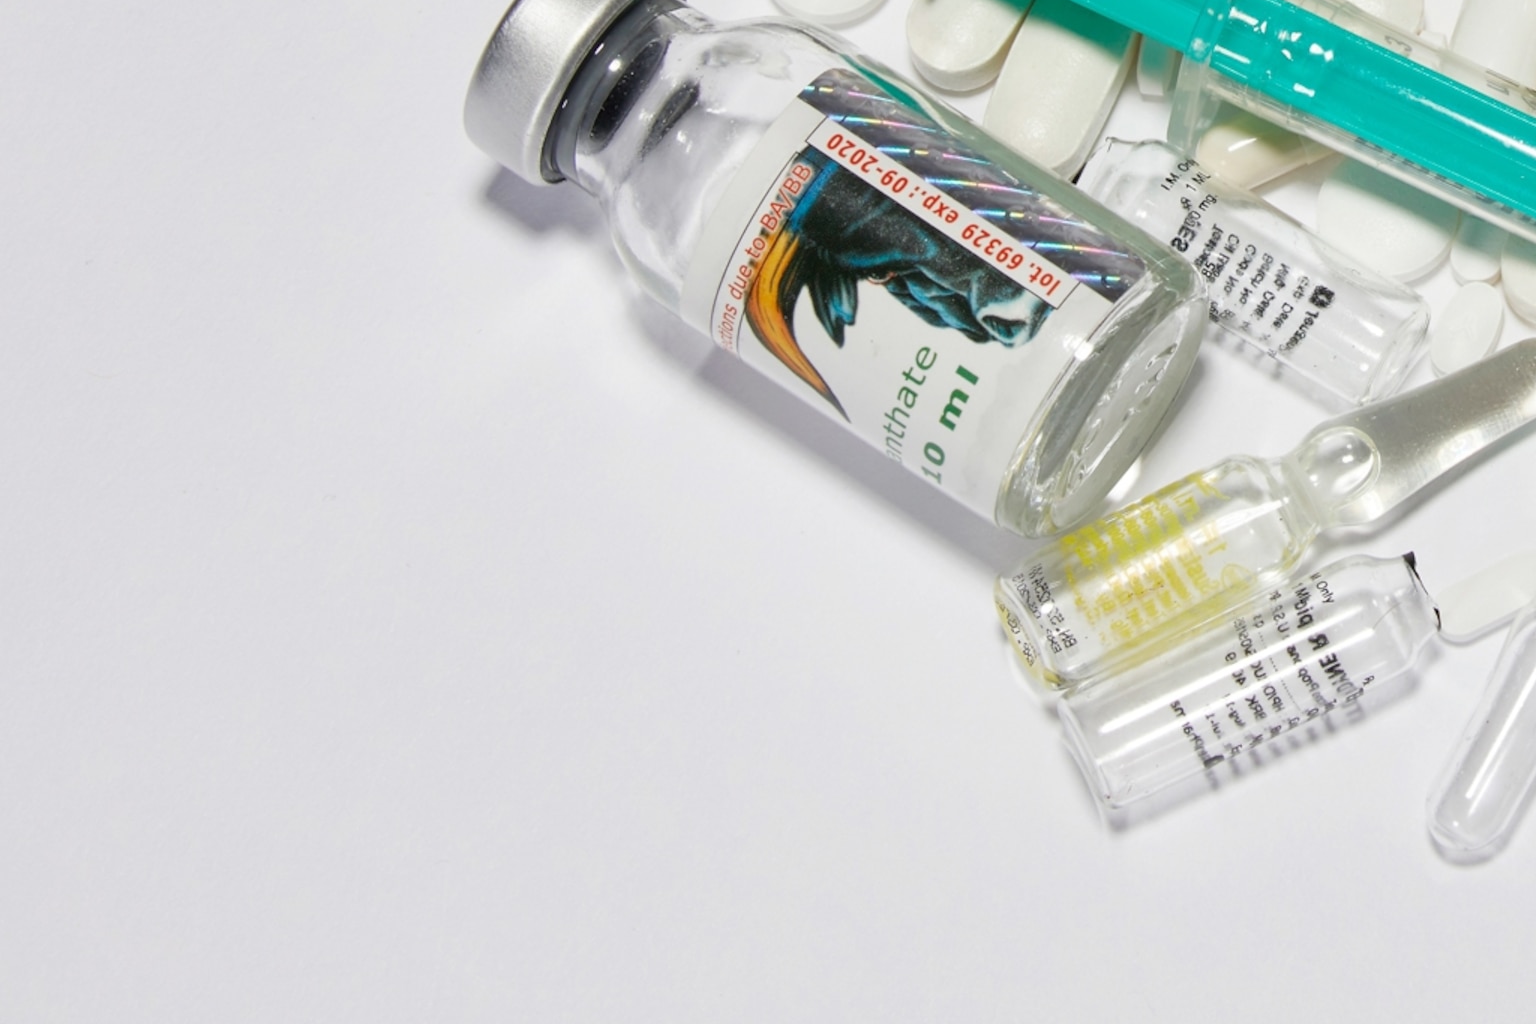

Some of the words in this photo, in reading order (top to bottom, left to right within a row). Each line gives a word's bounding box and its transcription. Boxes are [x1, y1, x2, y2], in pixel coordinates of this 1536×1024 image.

[826, 133, 909, 194] 09-2020
[908, 186, 959, 224] exp.:
[728, 264, 754, 301] due
[744, 236, 766, 259] to
[760, 163, 812, 231] BA/BB
[961, 223, 1024, 270] 69329
[1028, 263, 1061, 296] lot.
[921, 441, 946, 485] 10
[939, 364, 980, 431] ml
[1316, 580, 1335, 604] Only
